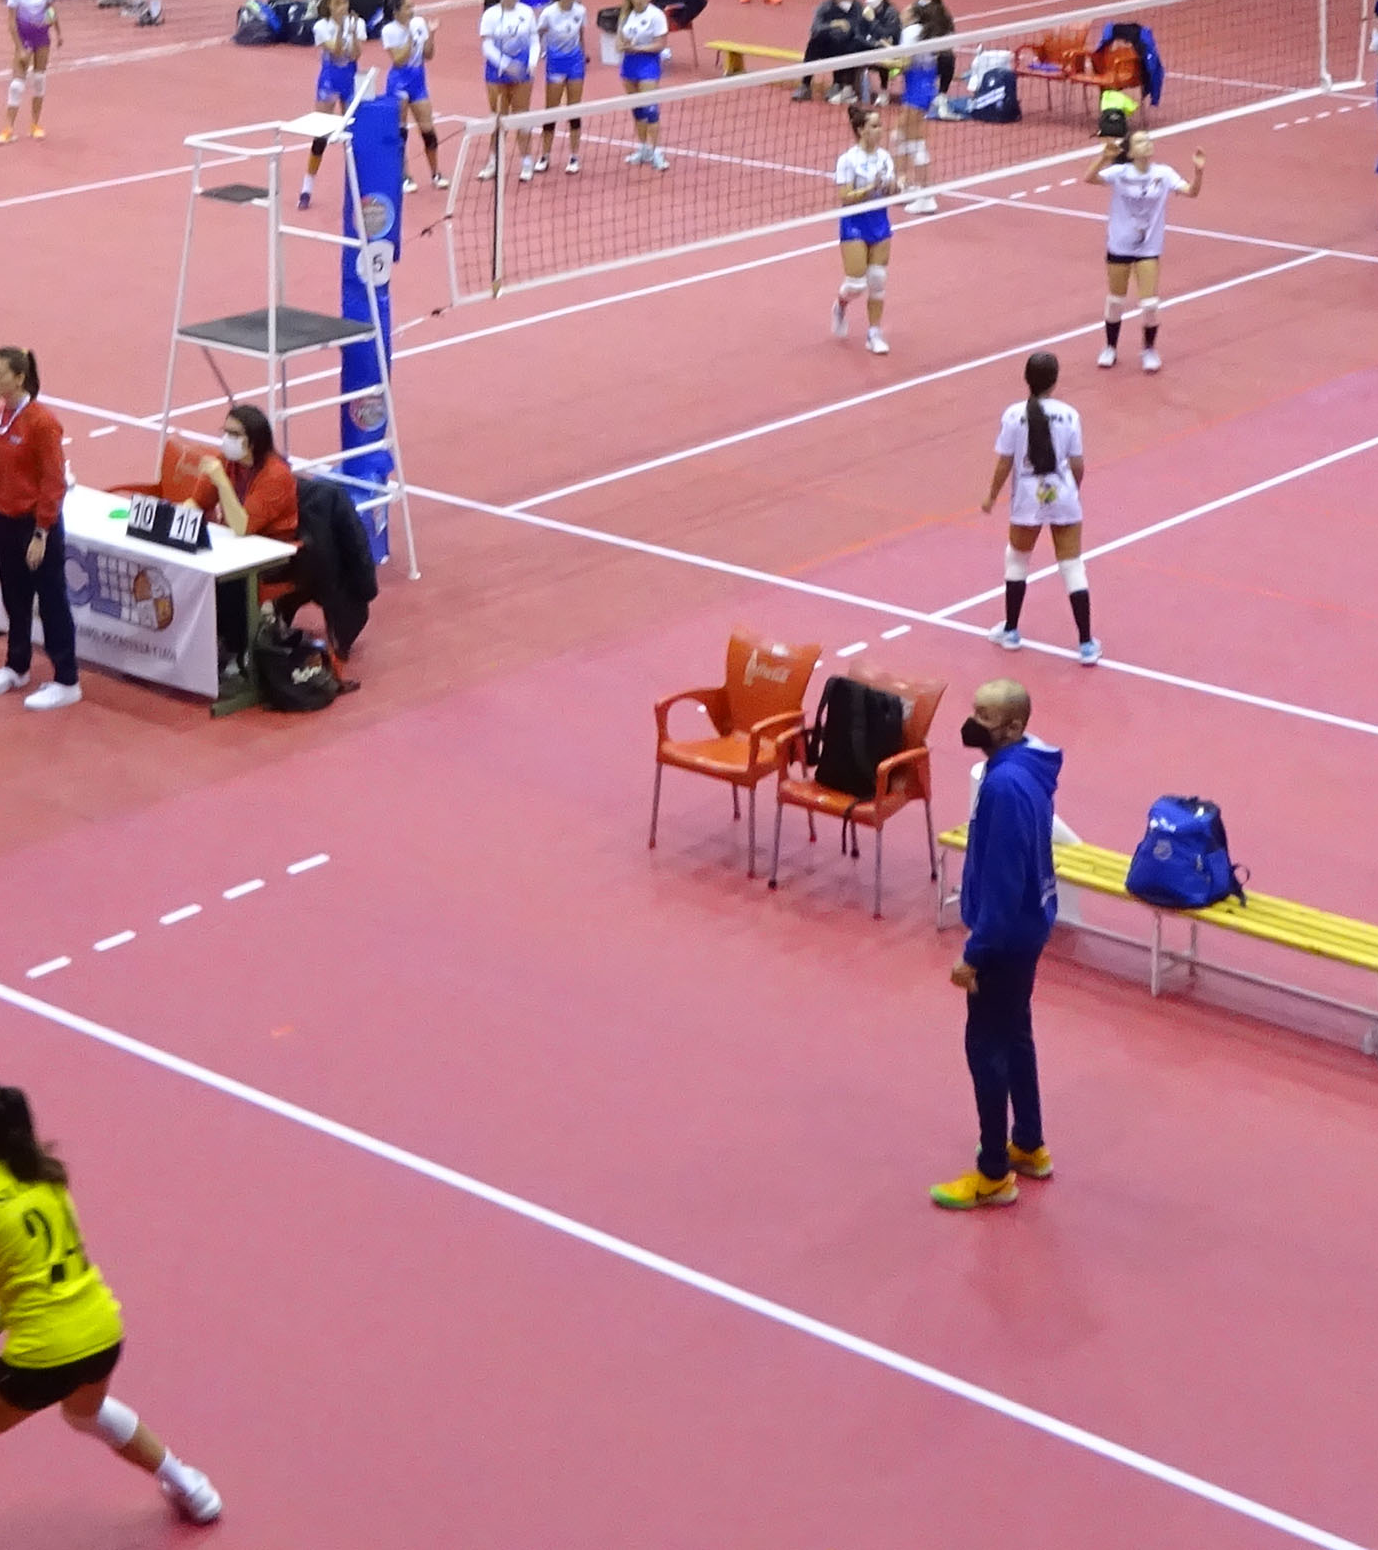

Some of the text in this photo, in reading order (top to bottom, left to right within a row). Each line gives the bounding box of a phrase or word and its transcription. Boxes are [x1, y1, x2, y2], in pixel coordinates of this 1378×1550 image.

[372, 254, 385, 273] 5
[133, 501, 199, 540] 10 11
